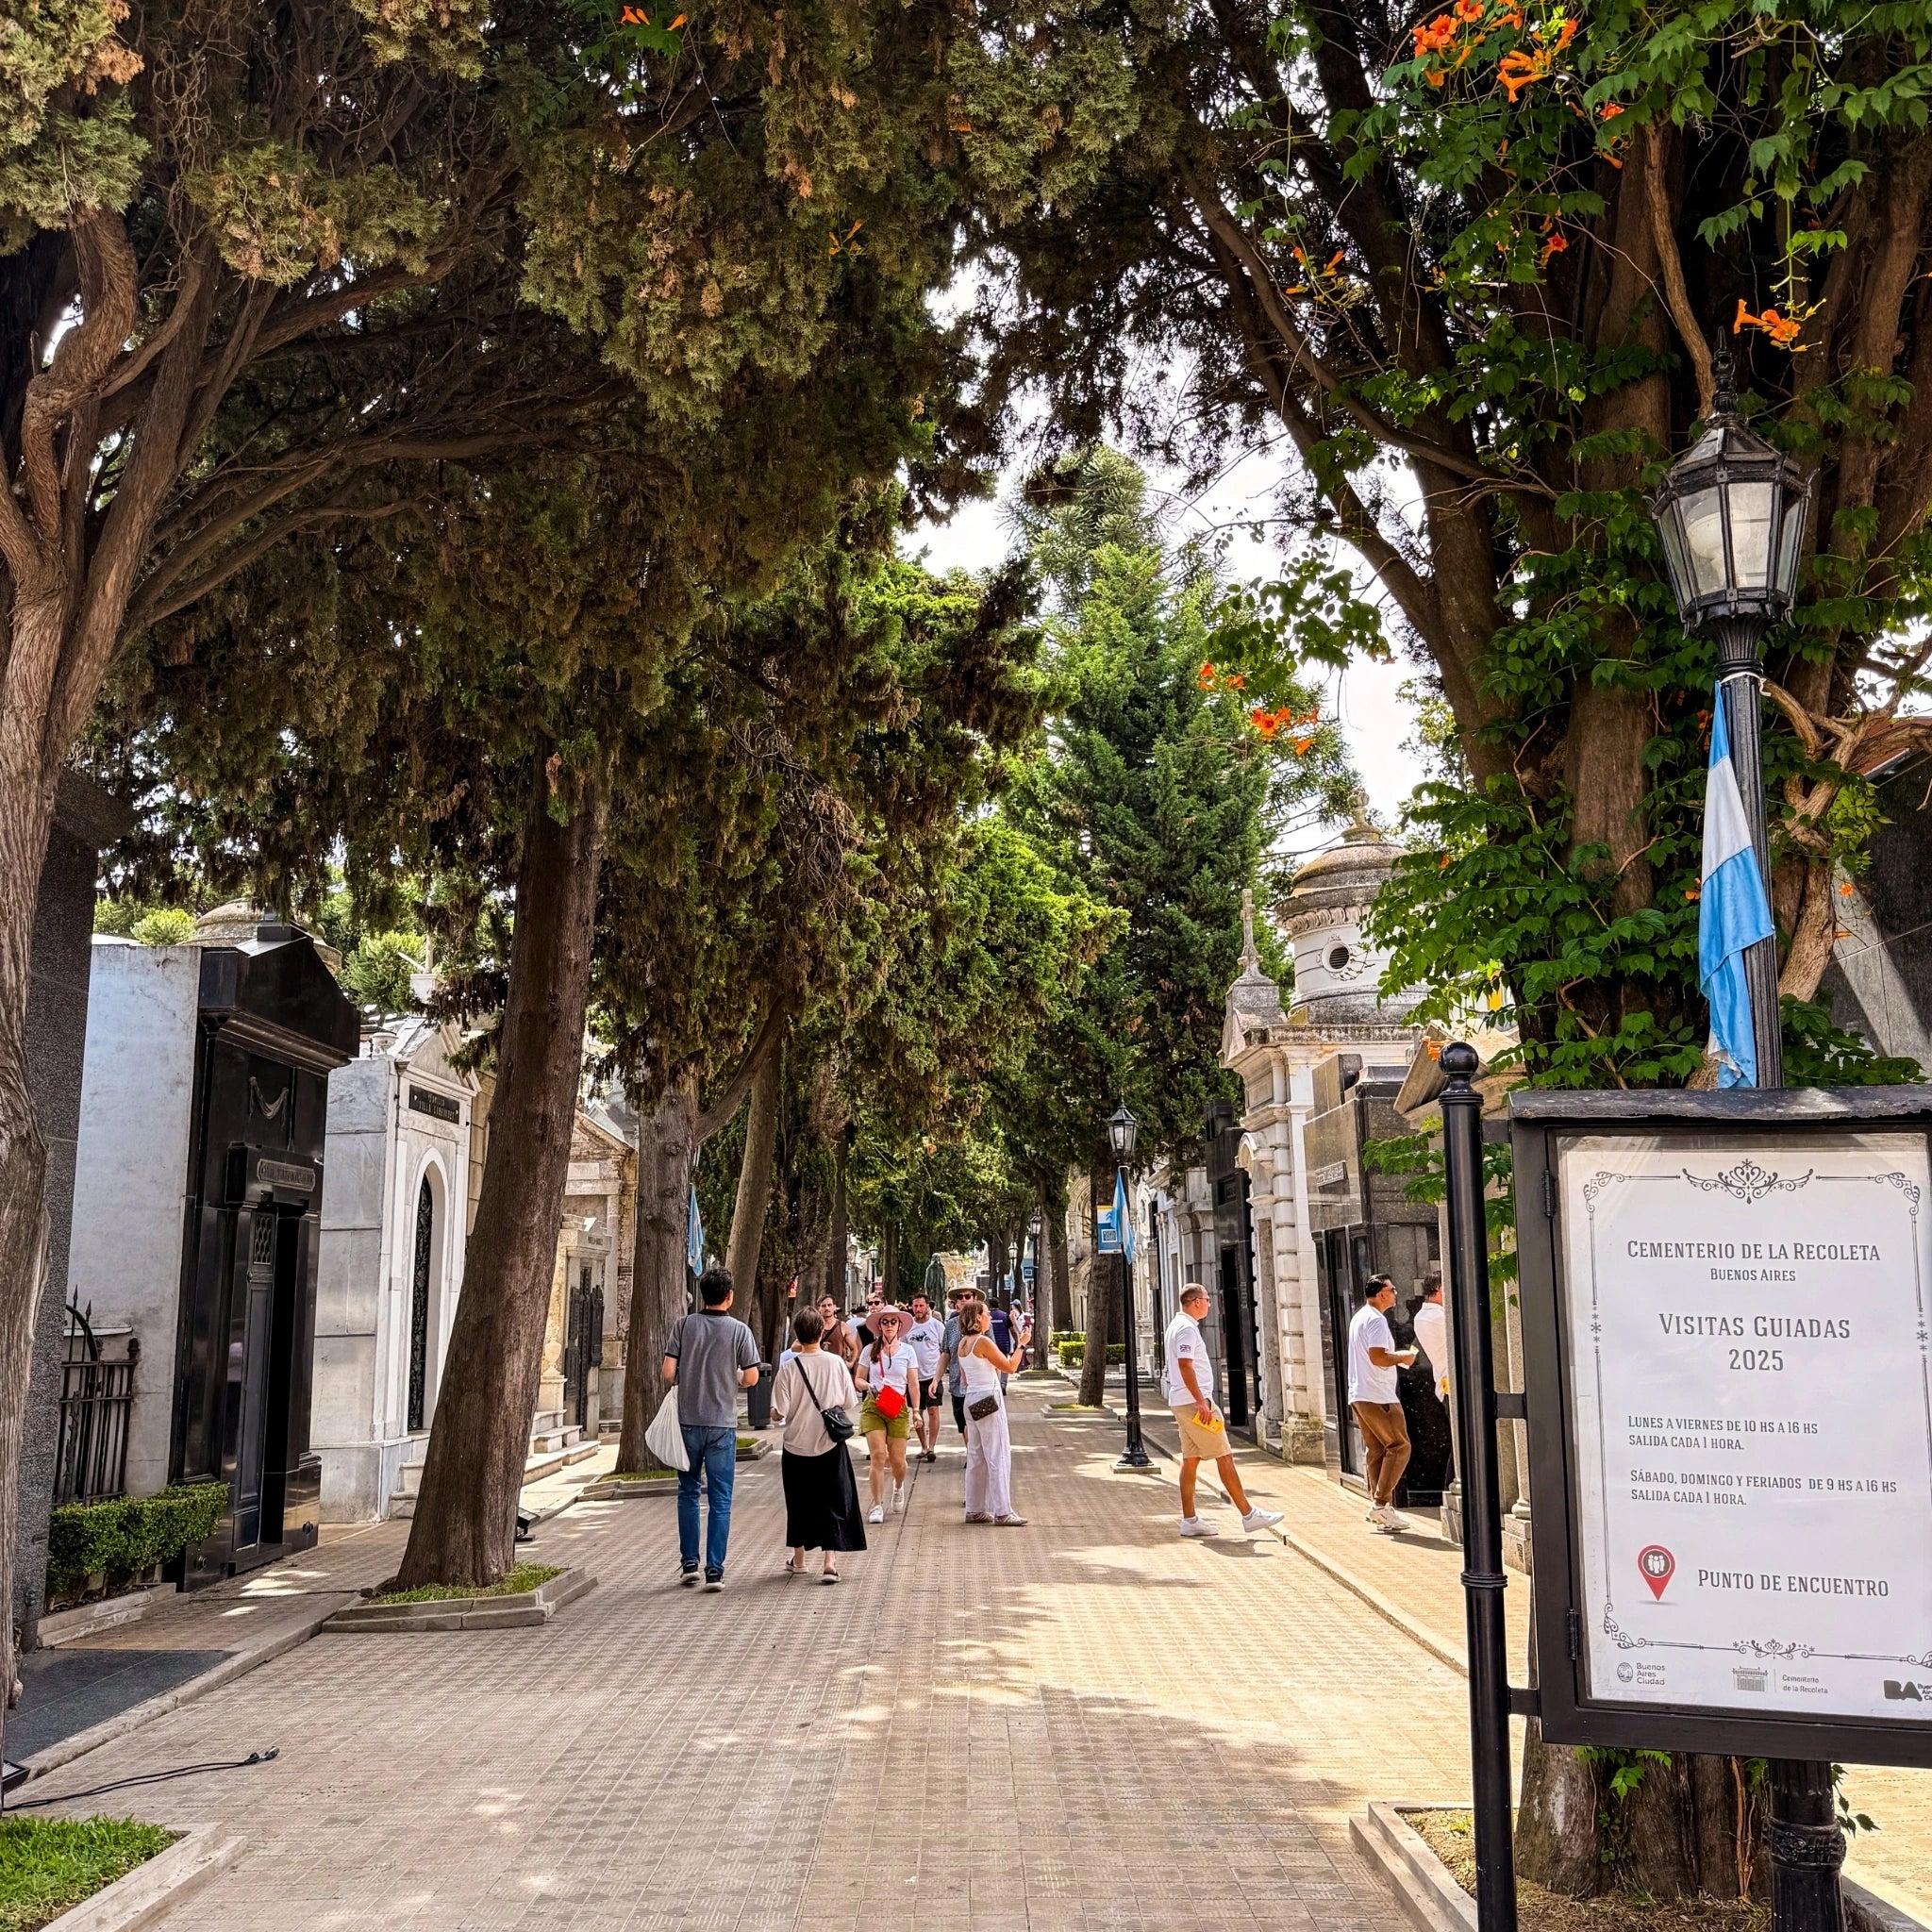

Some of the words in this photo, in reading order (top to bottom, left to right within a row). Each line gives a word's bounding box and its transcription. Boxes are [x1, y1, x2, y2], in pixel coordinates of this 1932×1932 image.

[1627, 1241, 1735, 1259] CEMENTERIO
[1741, 1243, 1763, 1259] DE
[1768, 1243, 1789, 1259] LA
[1793, 1242, 1881, 1261] RECOLETA
[1710, 1268, 1757, 1281] BUENOS
[1760, 1269, 1796, 1282] AIRES
[1658, 1313, 1744, 1337] VISITAS
[1754, 1315, 1851, 1339] GUIADAS
[1728, 1348, 1784, 1372] 2025
[1628, 1415, 1663, 1429] LUNES
[1666, 1418, 1674, 1429] A
[1675, 1418, 1724, 1431] VIERNES
[1726, 1420, 1741, 1432] DE
[1744, 1420, 1757, 1433] 10
[1760, 1421, 1774, 1433] HS
[1777, 1422, 1786, 1434] A
[1788, 1421, 1800, 1434] 16
[1803, 1423, 1819, 1435] HS
[1629, 1434, 1668, 1447] SALIDA
[1671, 1436, 1701, 1449] CADA
[1710, 1438, 1744, 1450] HORA.
[1630, 1469, 1677, 1486] SÁBADO,
[1680, 1473, 1733, 1487] DOMINGO
[1736, 1474, 1743, 1487] Y
[1746, 1475, 1802, 1490] FERIADOS
[1808, 1478, 1824, 1491] DE
[1826, 1478, 1834, 1491] 9
[1838, 1479, 1853, 1491] HS
[1855, 1480, 1864, 1492] A
[1866, 1479, 1878, 1492] 16
[1882, 1481, 1897, 1493] HS
[1631, 1489, 1671, 1502] SALIDA
[1674, 1491, 1704, 1504] CADA
[1713, 1492, 1747, 1506] HORA.
[1698, 1569, 1754, 1590] PUNTO
[1760, 1574, 1782, 1591] DE
[1788, 1575, 1889, 1597] ENCUENTRO
[1636, 1662, 1666, 1671] Buenos
[1636, 1677, 1666, 1686] Ciudad
[1800, 1685, 1829, 1694] Recoleta
